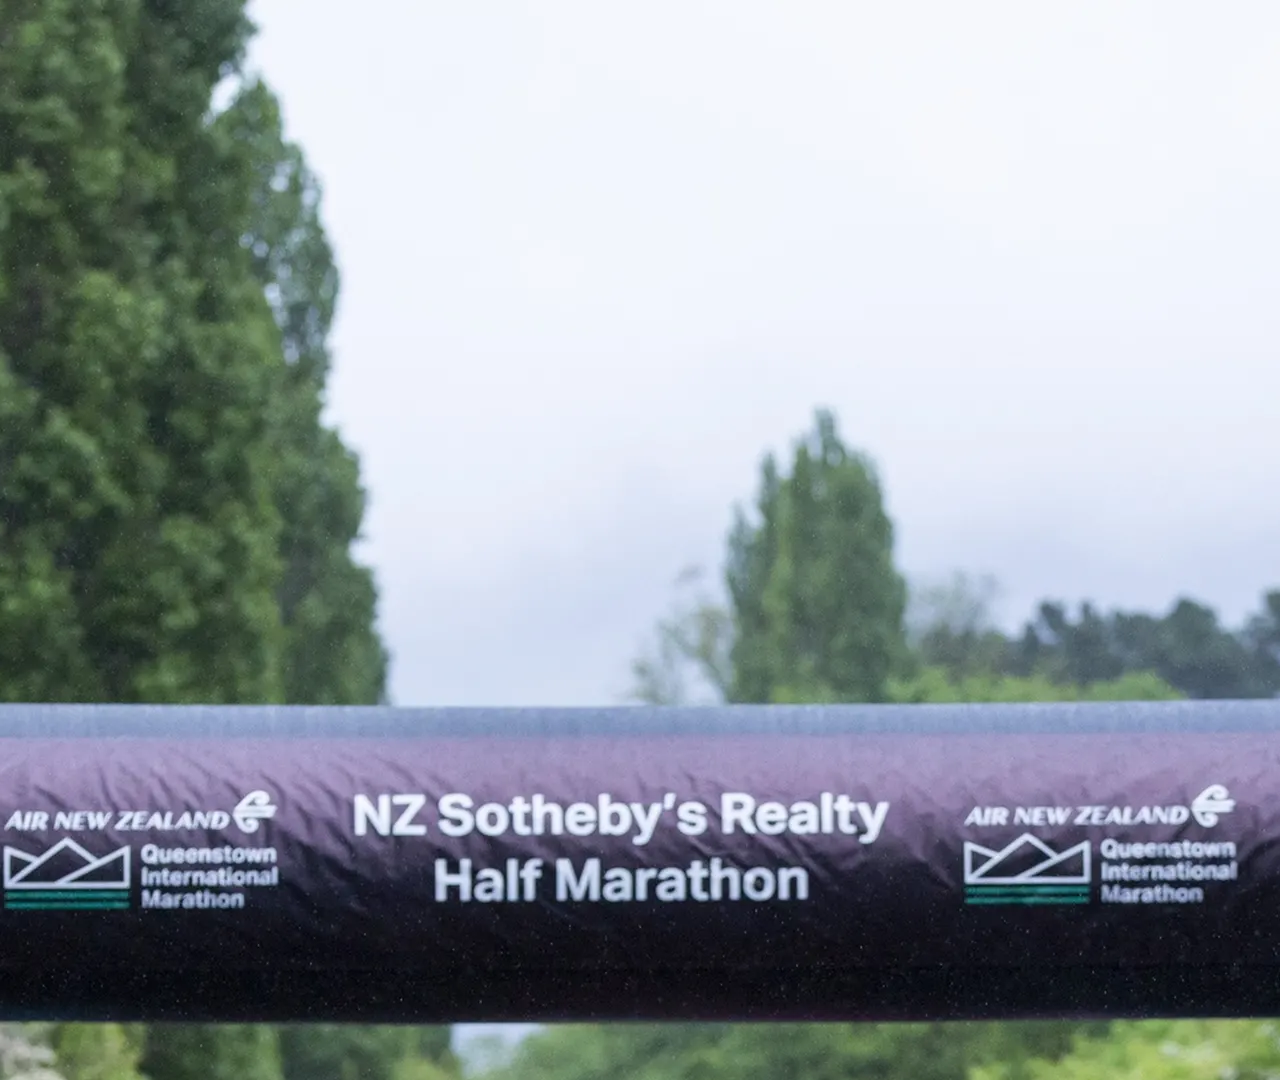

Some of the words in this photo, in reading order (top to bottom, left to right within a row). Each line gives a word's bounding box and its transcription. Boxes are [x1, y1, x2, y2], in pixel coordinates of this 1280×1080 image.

[4, 810, 51, 832] AIR
[52, 810, 115, 832] NEW
[115, 809, 230, 831] ZEALAND
[353, 793, 428, 836] NZ
[437, 792, 707, 845] Sotheby's
[721, 792, 889, 845] Realty
[964, 806, 1009, 827] AIR
[1013, 806, 1075, 827] NEW
[1075, 805, 1190, 826] ZEALAND
[141, 843, 277, 866] Queenstown
[1100, 838, 1237, 861] Queenstown
[141, 866, 279, 887] International
[433, 857, 540, 902] Half
[555, 857, 809, 902] Marathon
[1100, 860, 1238, 881] International
[141, 888, 245, 909] Marathon
[1100, 883, 1204, 903] Marathon
